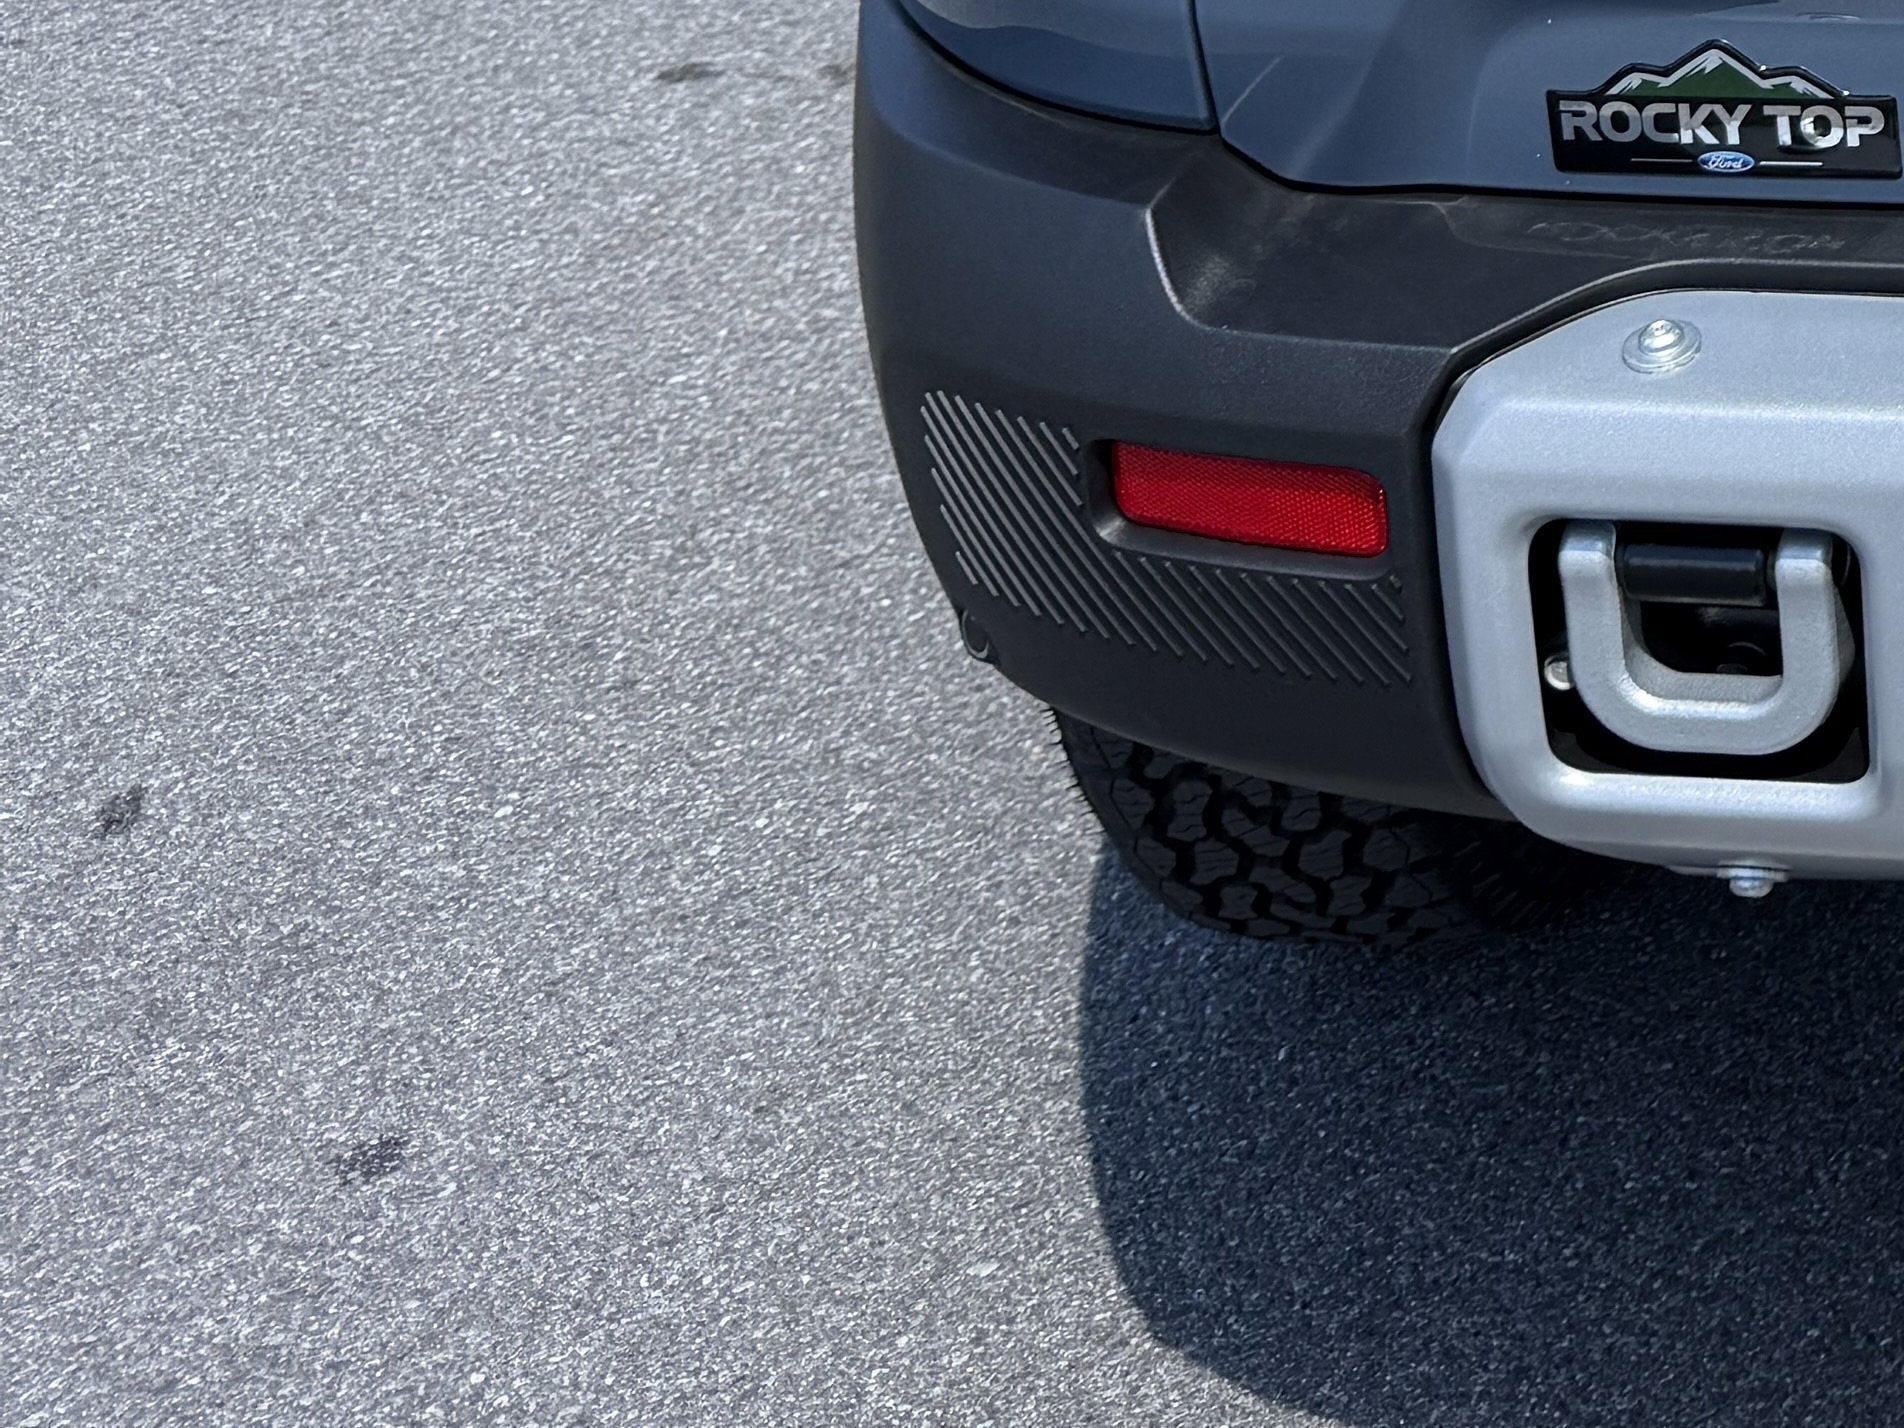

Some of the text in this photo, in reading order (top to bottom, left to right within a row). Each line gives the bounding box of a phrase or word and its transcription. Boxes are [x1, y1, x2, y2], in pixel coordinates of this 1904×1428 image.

[1558, 99, 1886, 150] ROCKY TOP
[1707, 154, 1745, 169] Ford
